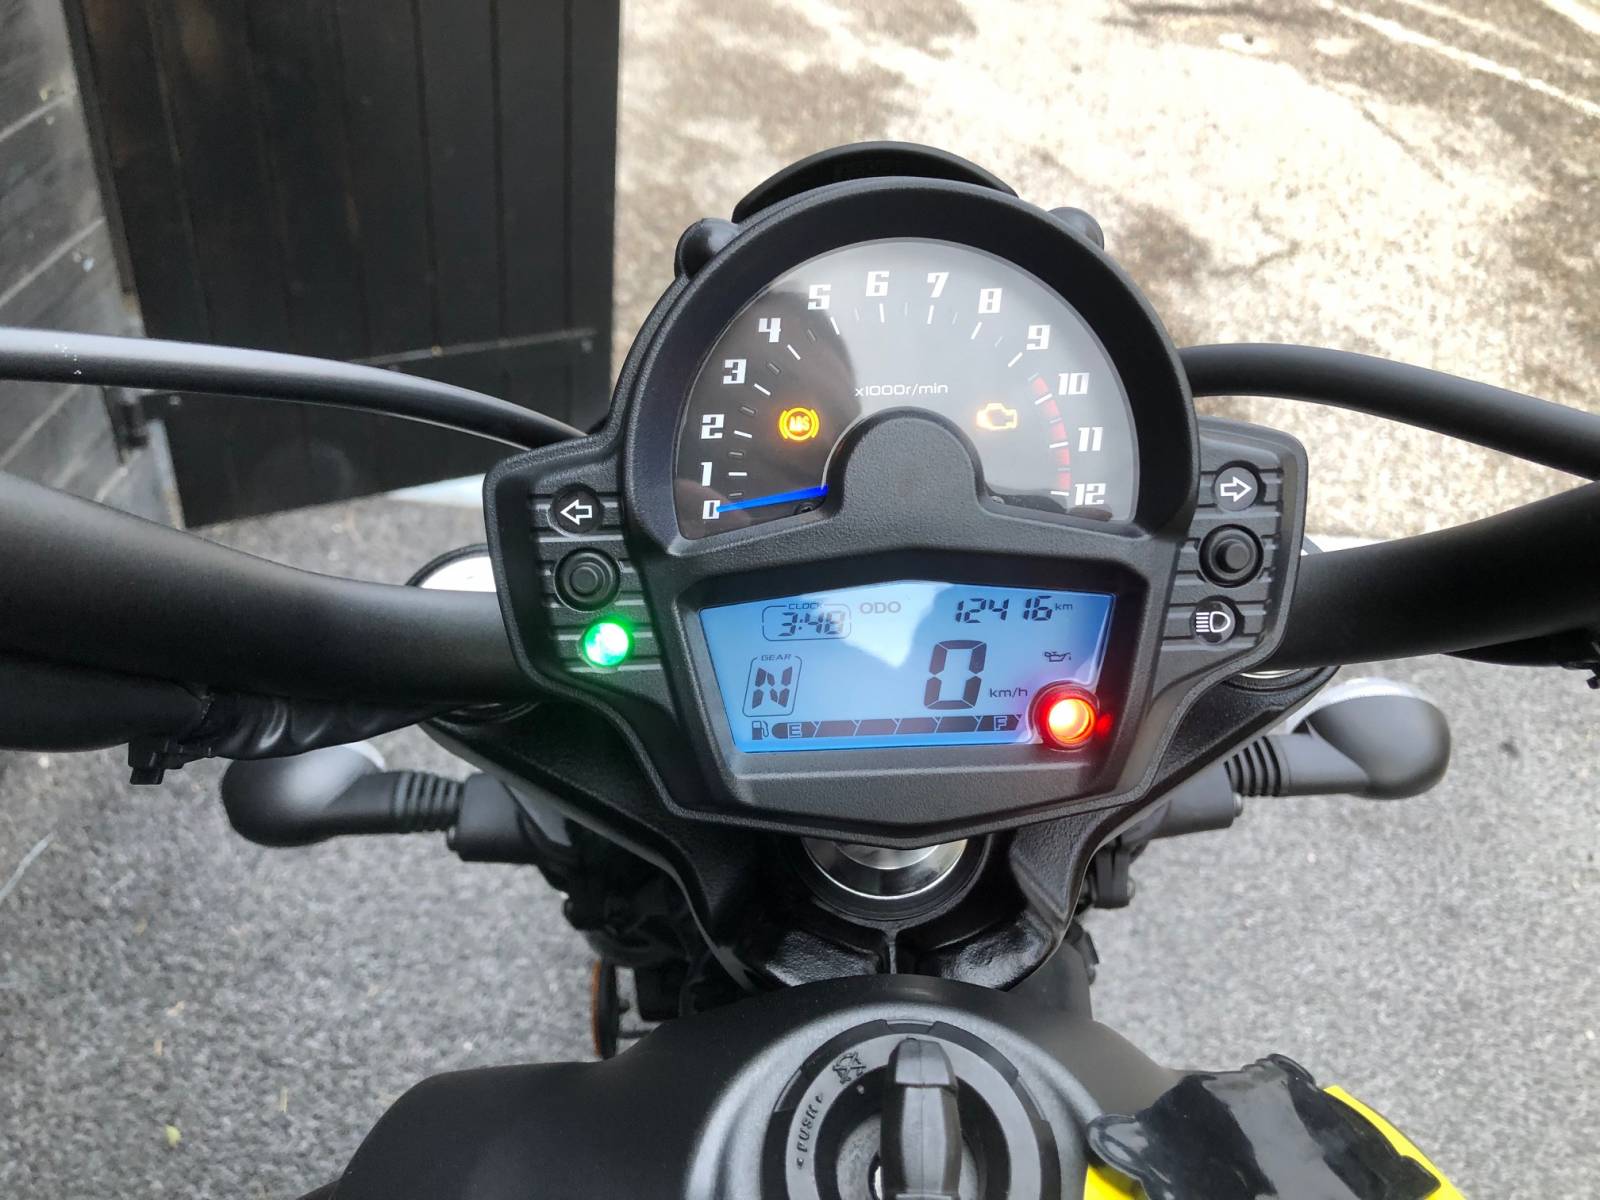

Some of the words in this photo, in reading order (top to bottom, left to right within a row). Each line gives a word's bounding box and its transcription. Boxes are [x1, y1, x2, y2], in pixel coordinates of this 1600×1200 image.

[807, 283, 832, 310] 5
[865, 270, 890, 297] 6
[927, 271, 949, 298] 7
[978, 287, 1003, 314] 8
[758, 317, 782, 343] 4
[1026, 324, 1051, 351] 9
[722, 358, 747, 385] 3
[1058, 372, 1090, 396] 10
[700, 413, 725, 440] 2
[1077, 426, 1104, 452] 11
[700, 461, 713, 487] 1
[1074, 483, 1107, 506] 12
[702, 499, 721, 520] 0
[788, 602, 823, 611] CLOCK
[860, 601, 902, 614] ODO
[955, 595, 1053, 624] 12416
[1054, 602, 1073, 612] km
[777, 611, 846, 637] 3:48
[761, 653, 792, 662] GEAR
[752, 666, 793, 710] N
[923, 639, 987, 711] 0
[989, 687, 1028, 699] km/h
[788, 723, 803, 737] E
[994, 716, 1008, 731] F
